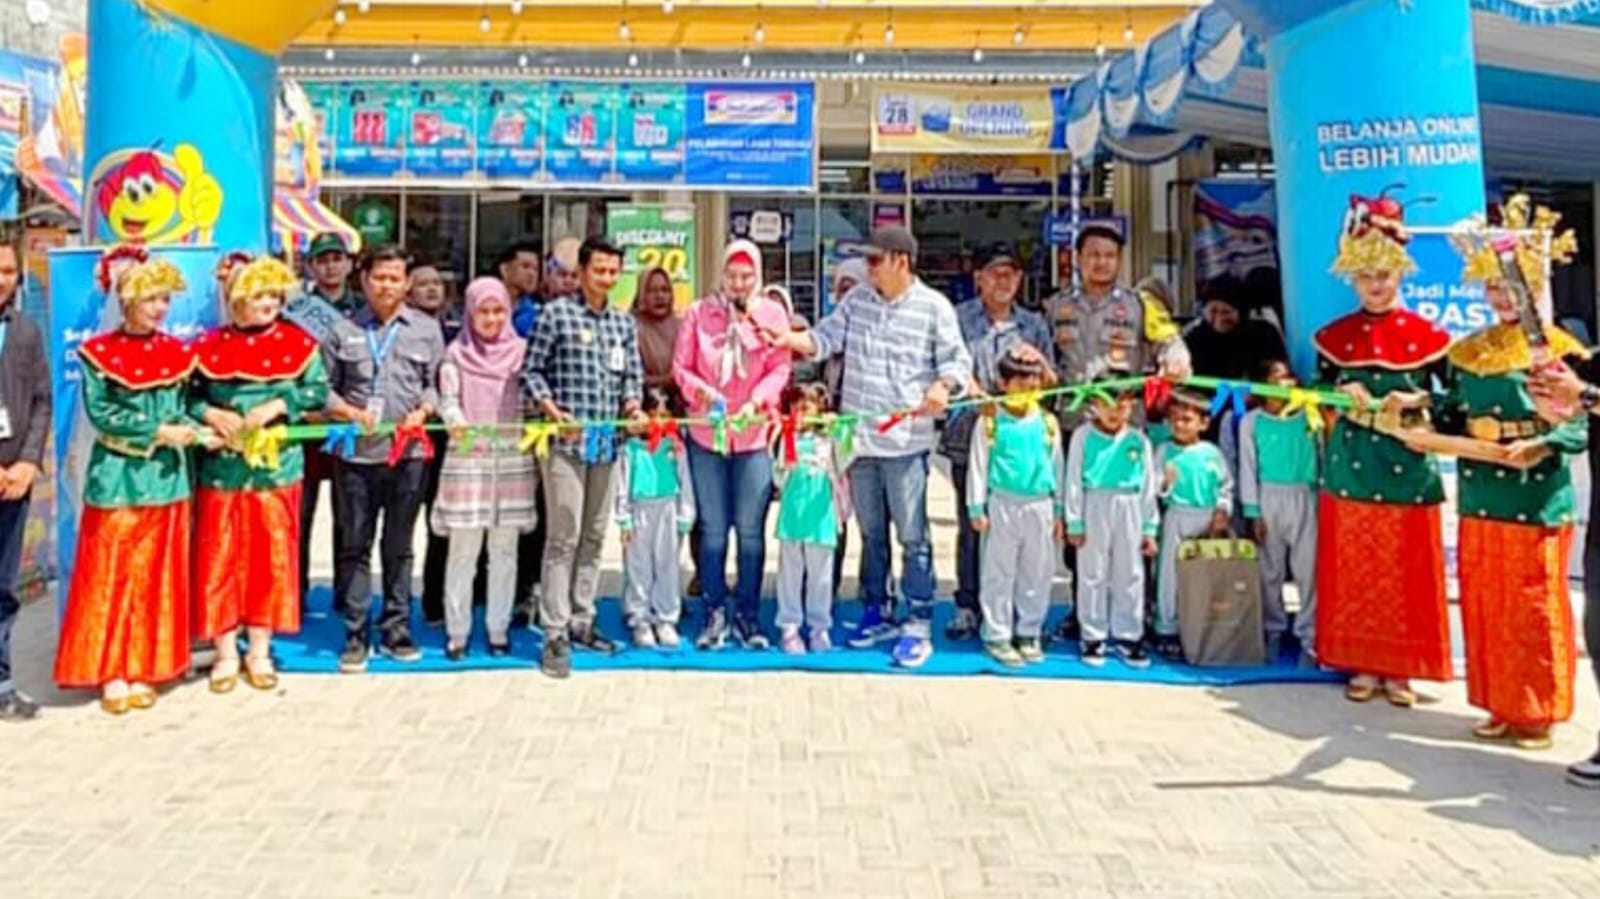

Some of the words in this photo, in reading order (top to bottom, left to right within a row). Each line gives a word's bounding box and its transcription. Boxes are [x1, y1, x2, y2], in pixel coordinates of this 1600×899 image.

[884, 107, 909, 124] 28
[966, 104, 1024, 119] GRAND
[1318, 119, 1417, 143] BELANJA
[1319, 147, 1400, 172] LEBIH
[616, 230, 687, 249] DISCOUNT
[1418, 302, 1497, 328] PAS
